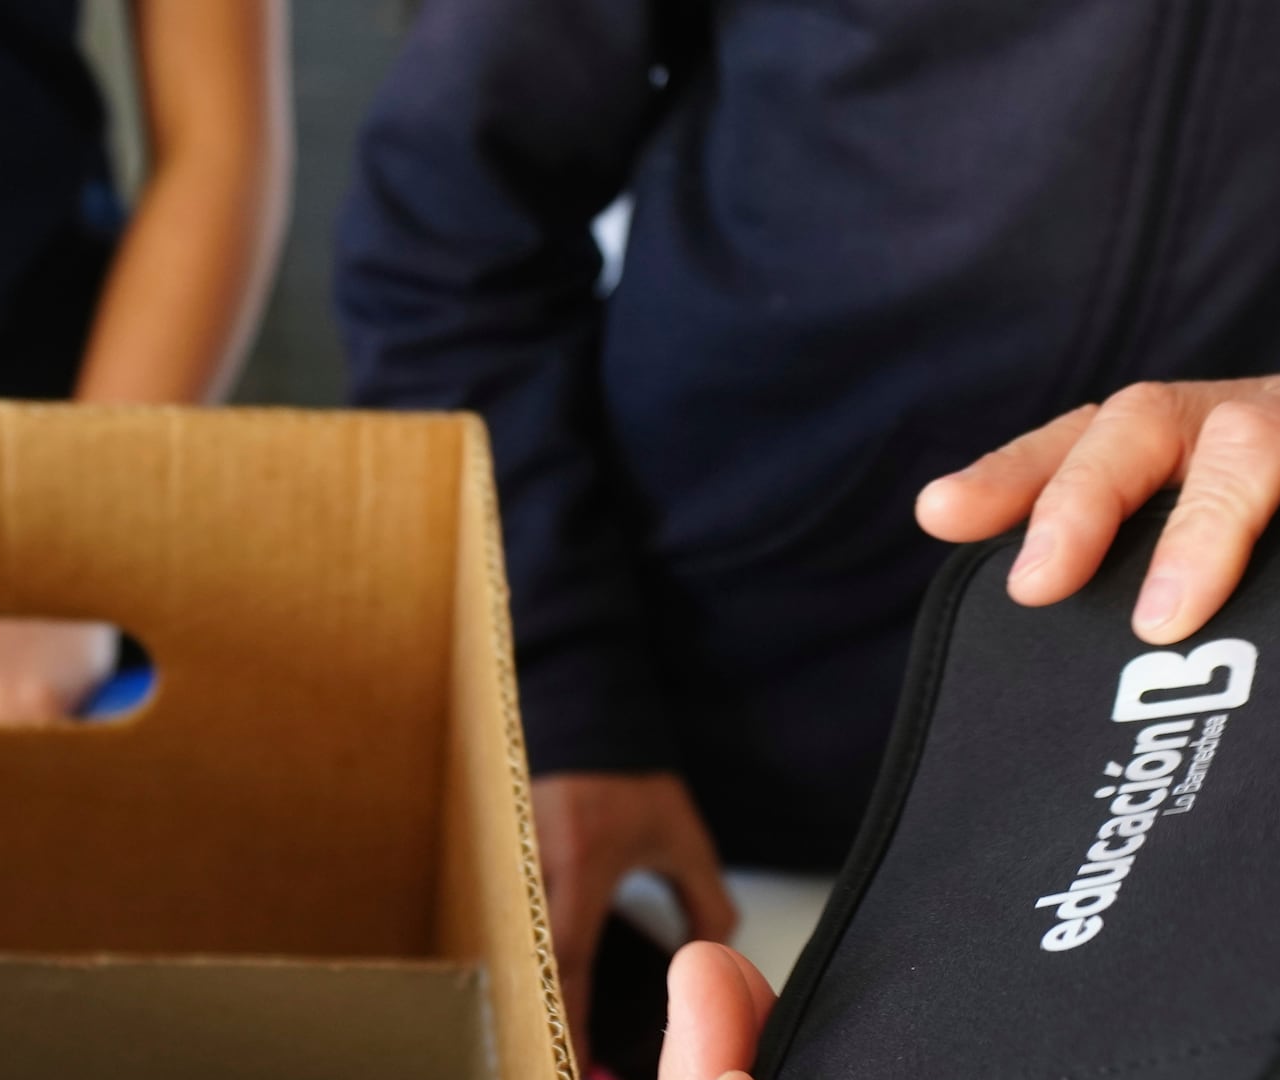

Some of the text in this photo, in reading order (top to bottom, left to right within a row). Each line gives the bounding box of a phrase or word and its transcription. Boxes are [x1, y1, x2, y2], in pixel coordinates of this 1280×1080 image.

[1035, 719, 1195, 952] educación
[1163, 713, 1229, 816] Lo Barnechea
